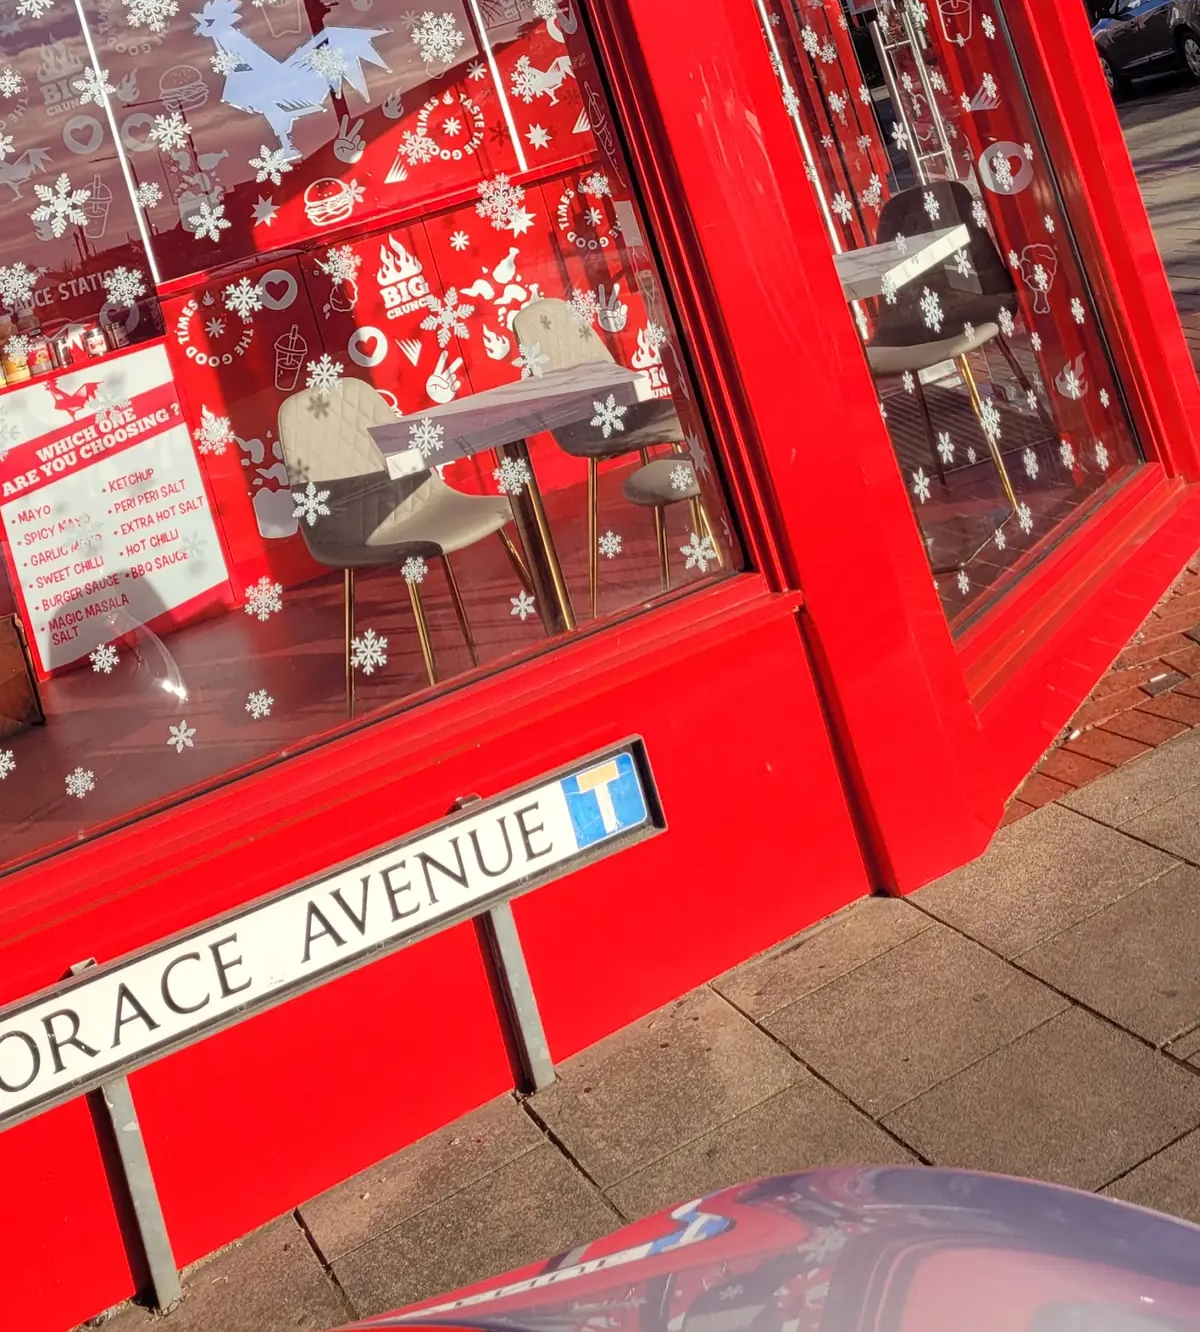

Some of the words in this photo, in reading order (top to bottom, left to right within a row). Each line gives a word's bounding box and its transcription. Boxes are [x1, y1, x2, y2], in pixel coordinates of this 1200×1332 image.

[459, 93, 485, 128] TASTE
[427, 139, 463, 160] GOO
[464, 132, 484, 155] THE
[557, 188, 575, 230] TIMES
[567, 231, 609, 250] GOOD
[58, 268, 118, 301] STATI
[380, 275, 430, 309] BIG
[174, 299, 199, 345] TIMES
[386, 296, 434, 320] CRUNC
[185, 346, 233, 367] GOOD
[233, 329, 254, 356] THE
[35, 425, 98, 462] WHICH
[99, 407, 137, 433] ONE
[2, 469, 41, 497] ARE
[40, 450, 77, 477] YOU
[79, 411, 170, 459] CHOOSING
[108, 468, 154, 493] KETCHUP
[114, 497, 136, 513] PERI
[137, 489, 160, 505] PERI
[160, 479, 186, 498] SALT
[17, 505, 51, 524] MAYO
[120, 514, 155, 535] EXTRA
[155, 505, 177, 523] HOT
[178, 496, 204, 514] SALT
[24, 525, 56, 546] SPICY
[125, 539, 147, 557] HOT
[149, 528, 180, 548] CHILLI
[30, 546, 69, 567] GARLIC
[130, 561, 153, 579] BBQ
[154, 551, 188, 567] SAUCE
[36, 566, 70, 588] SWEET
[74, 556, 105, 574] CHILLI
[41, 587, 83, 611] BURGER
[84, 573, 120, 595] SAUCE
[48, 610, 84, 632] MAGIC
[84, 593, 130, 618] MASALA
[52, 626, 79, 646] SALT
[0, 932, 253, 1093] ORACE
[300, 801, 554, 964] AVENUE
